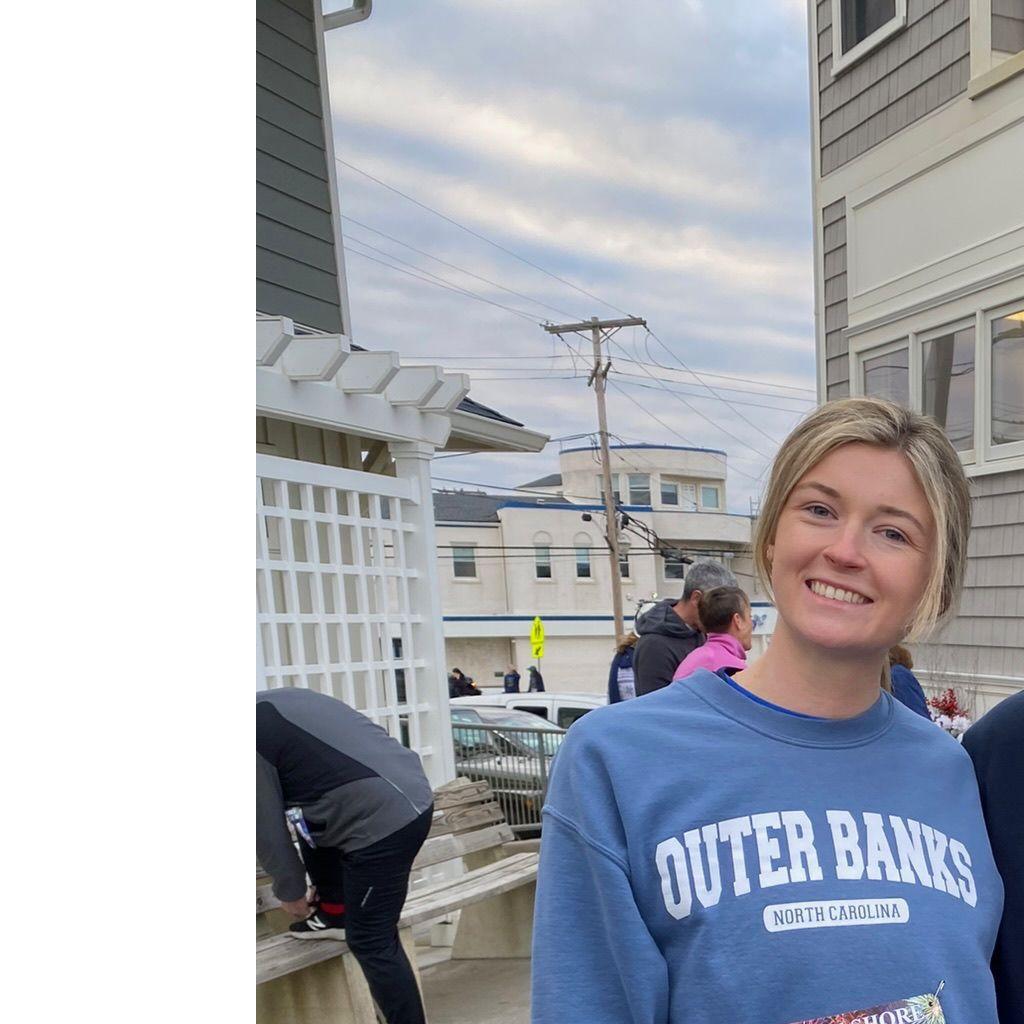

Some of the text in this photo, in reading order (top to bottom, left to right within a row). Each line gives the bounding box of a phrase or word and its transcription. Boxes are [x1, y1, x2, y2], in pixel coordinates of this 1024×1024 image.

[655, 809, 978, 920] OUTER BANKS
[773, 903, 901, 926] NORTH CAROLINA
